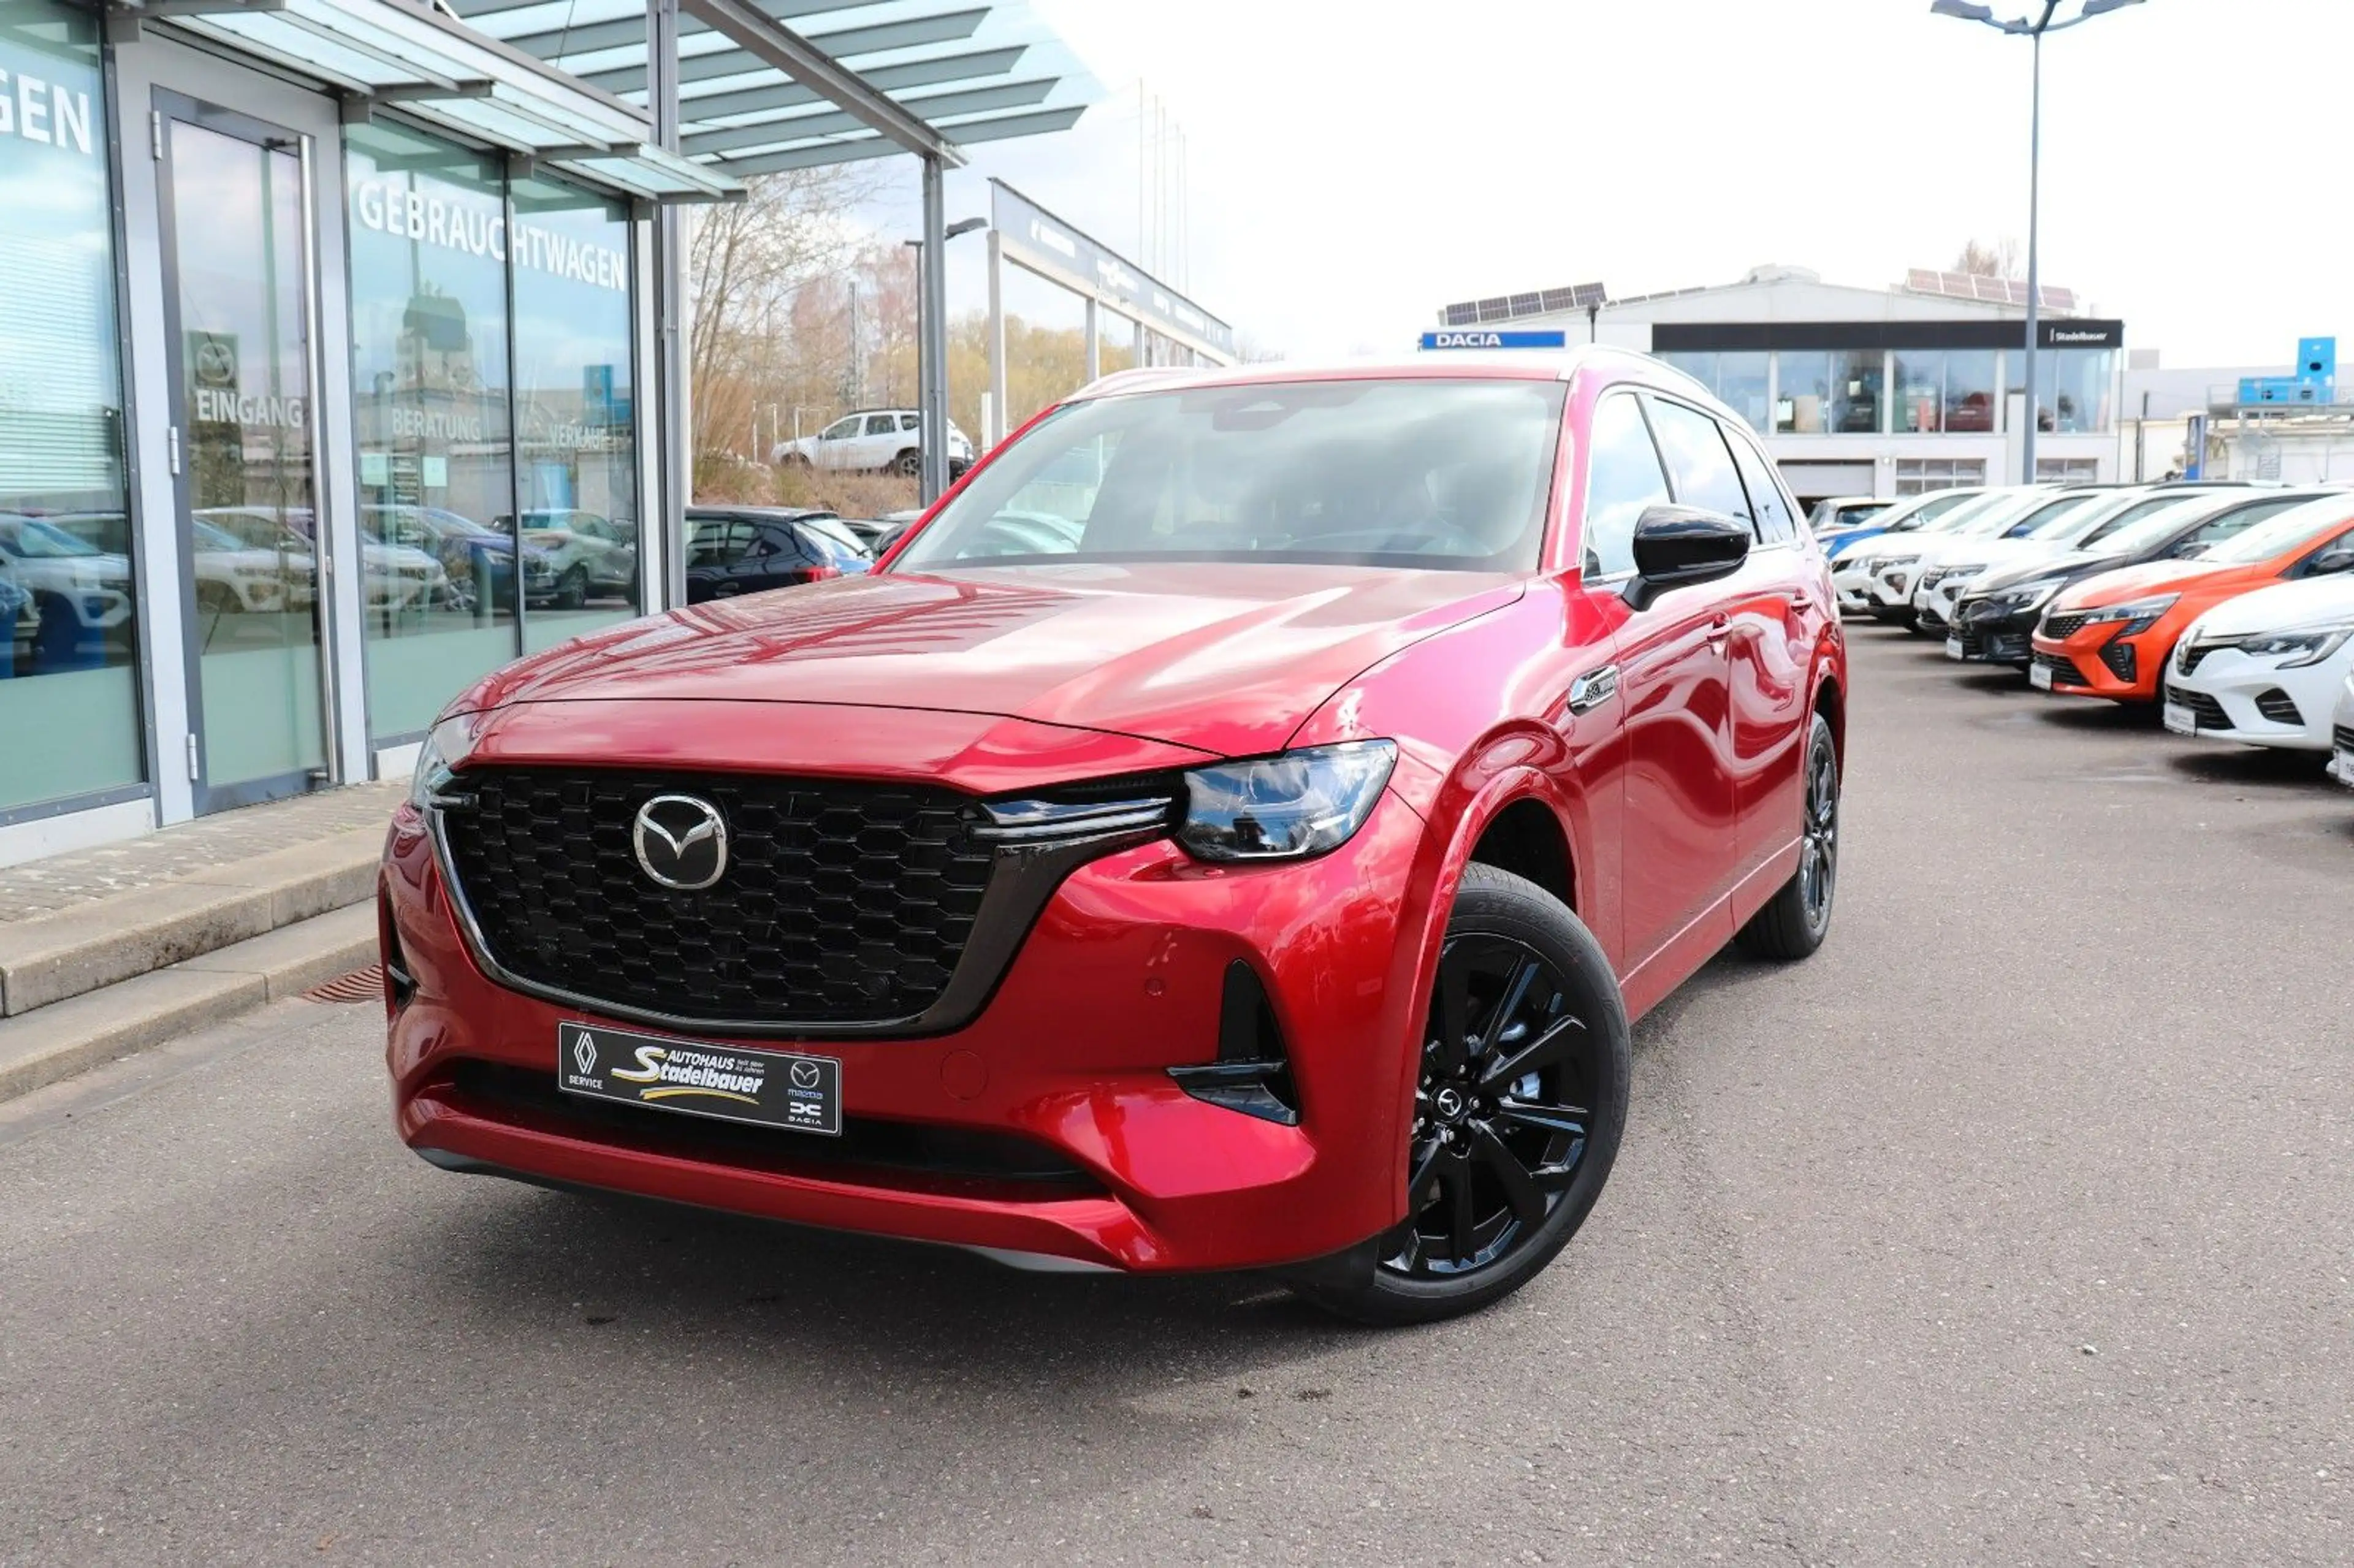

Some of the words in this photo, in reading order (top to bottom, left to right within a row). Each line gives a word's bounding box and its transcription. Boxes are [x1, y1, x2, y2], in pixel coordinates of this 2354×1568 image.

[359, 182, 625, 291] GEBRAUCHTWAGEN
[1436, 333, 1502, 347] DACIA
[196, 389, 304, 428] EINGANG
[391, 407, 482, 441] BERATUNG
[611, 1046, 764, 1094] Stadelbauer
[667, 1049, 735, 1071] AUTOHAUS
[568, 1075, 604, 1090] SERVICE
[788, 1116, 821, 1125] DACIA
